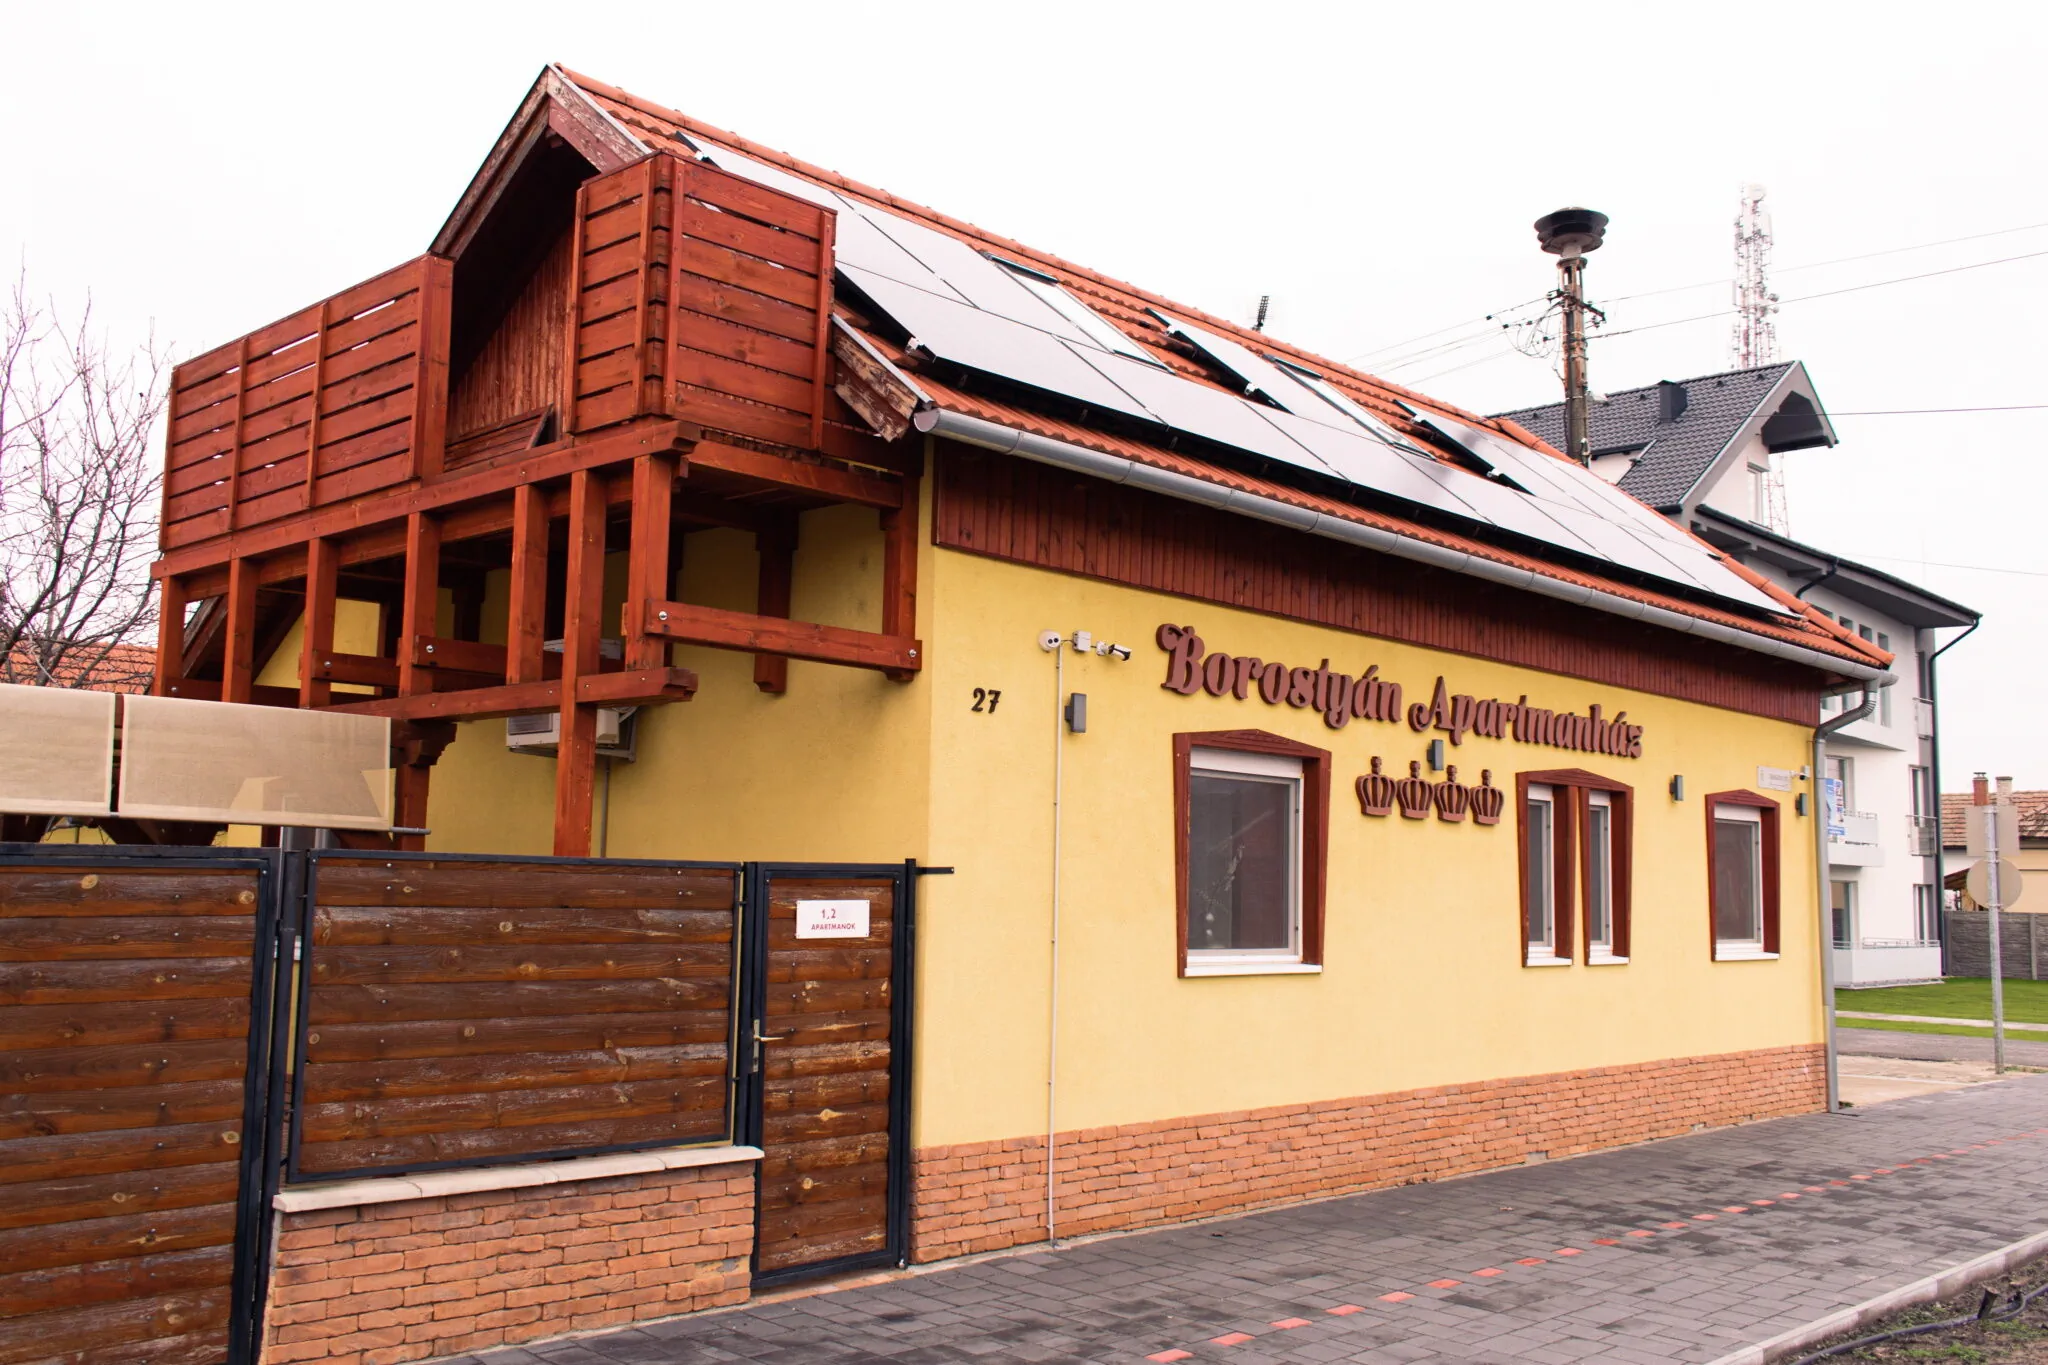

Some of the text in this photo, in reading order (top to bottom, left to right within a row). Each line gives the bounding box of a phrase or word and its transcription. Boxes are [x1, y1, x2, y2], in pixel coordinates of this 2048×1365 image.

[971, 687, 1001, 714] 27
[1156, 623, 1643, 758] Borostyán Apartmanház
